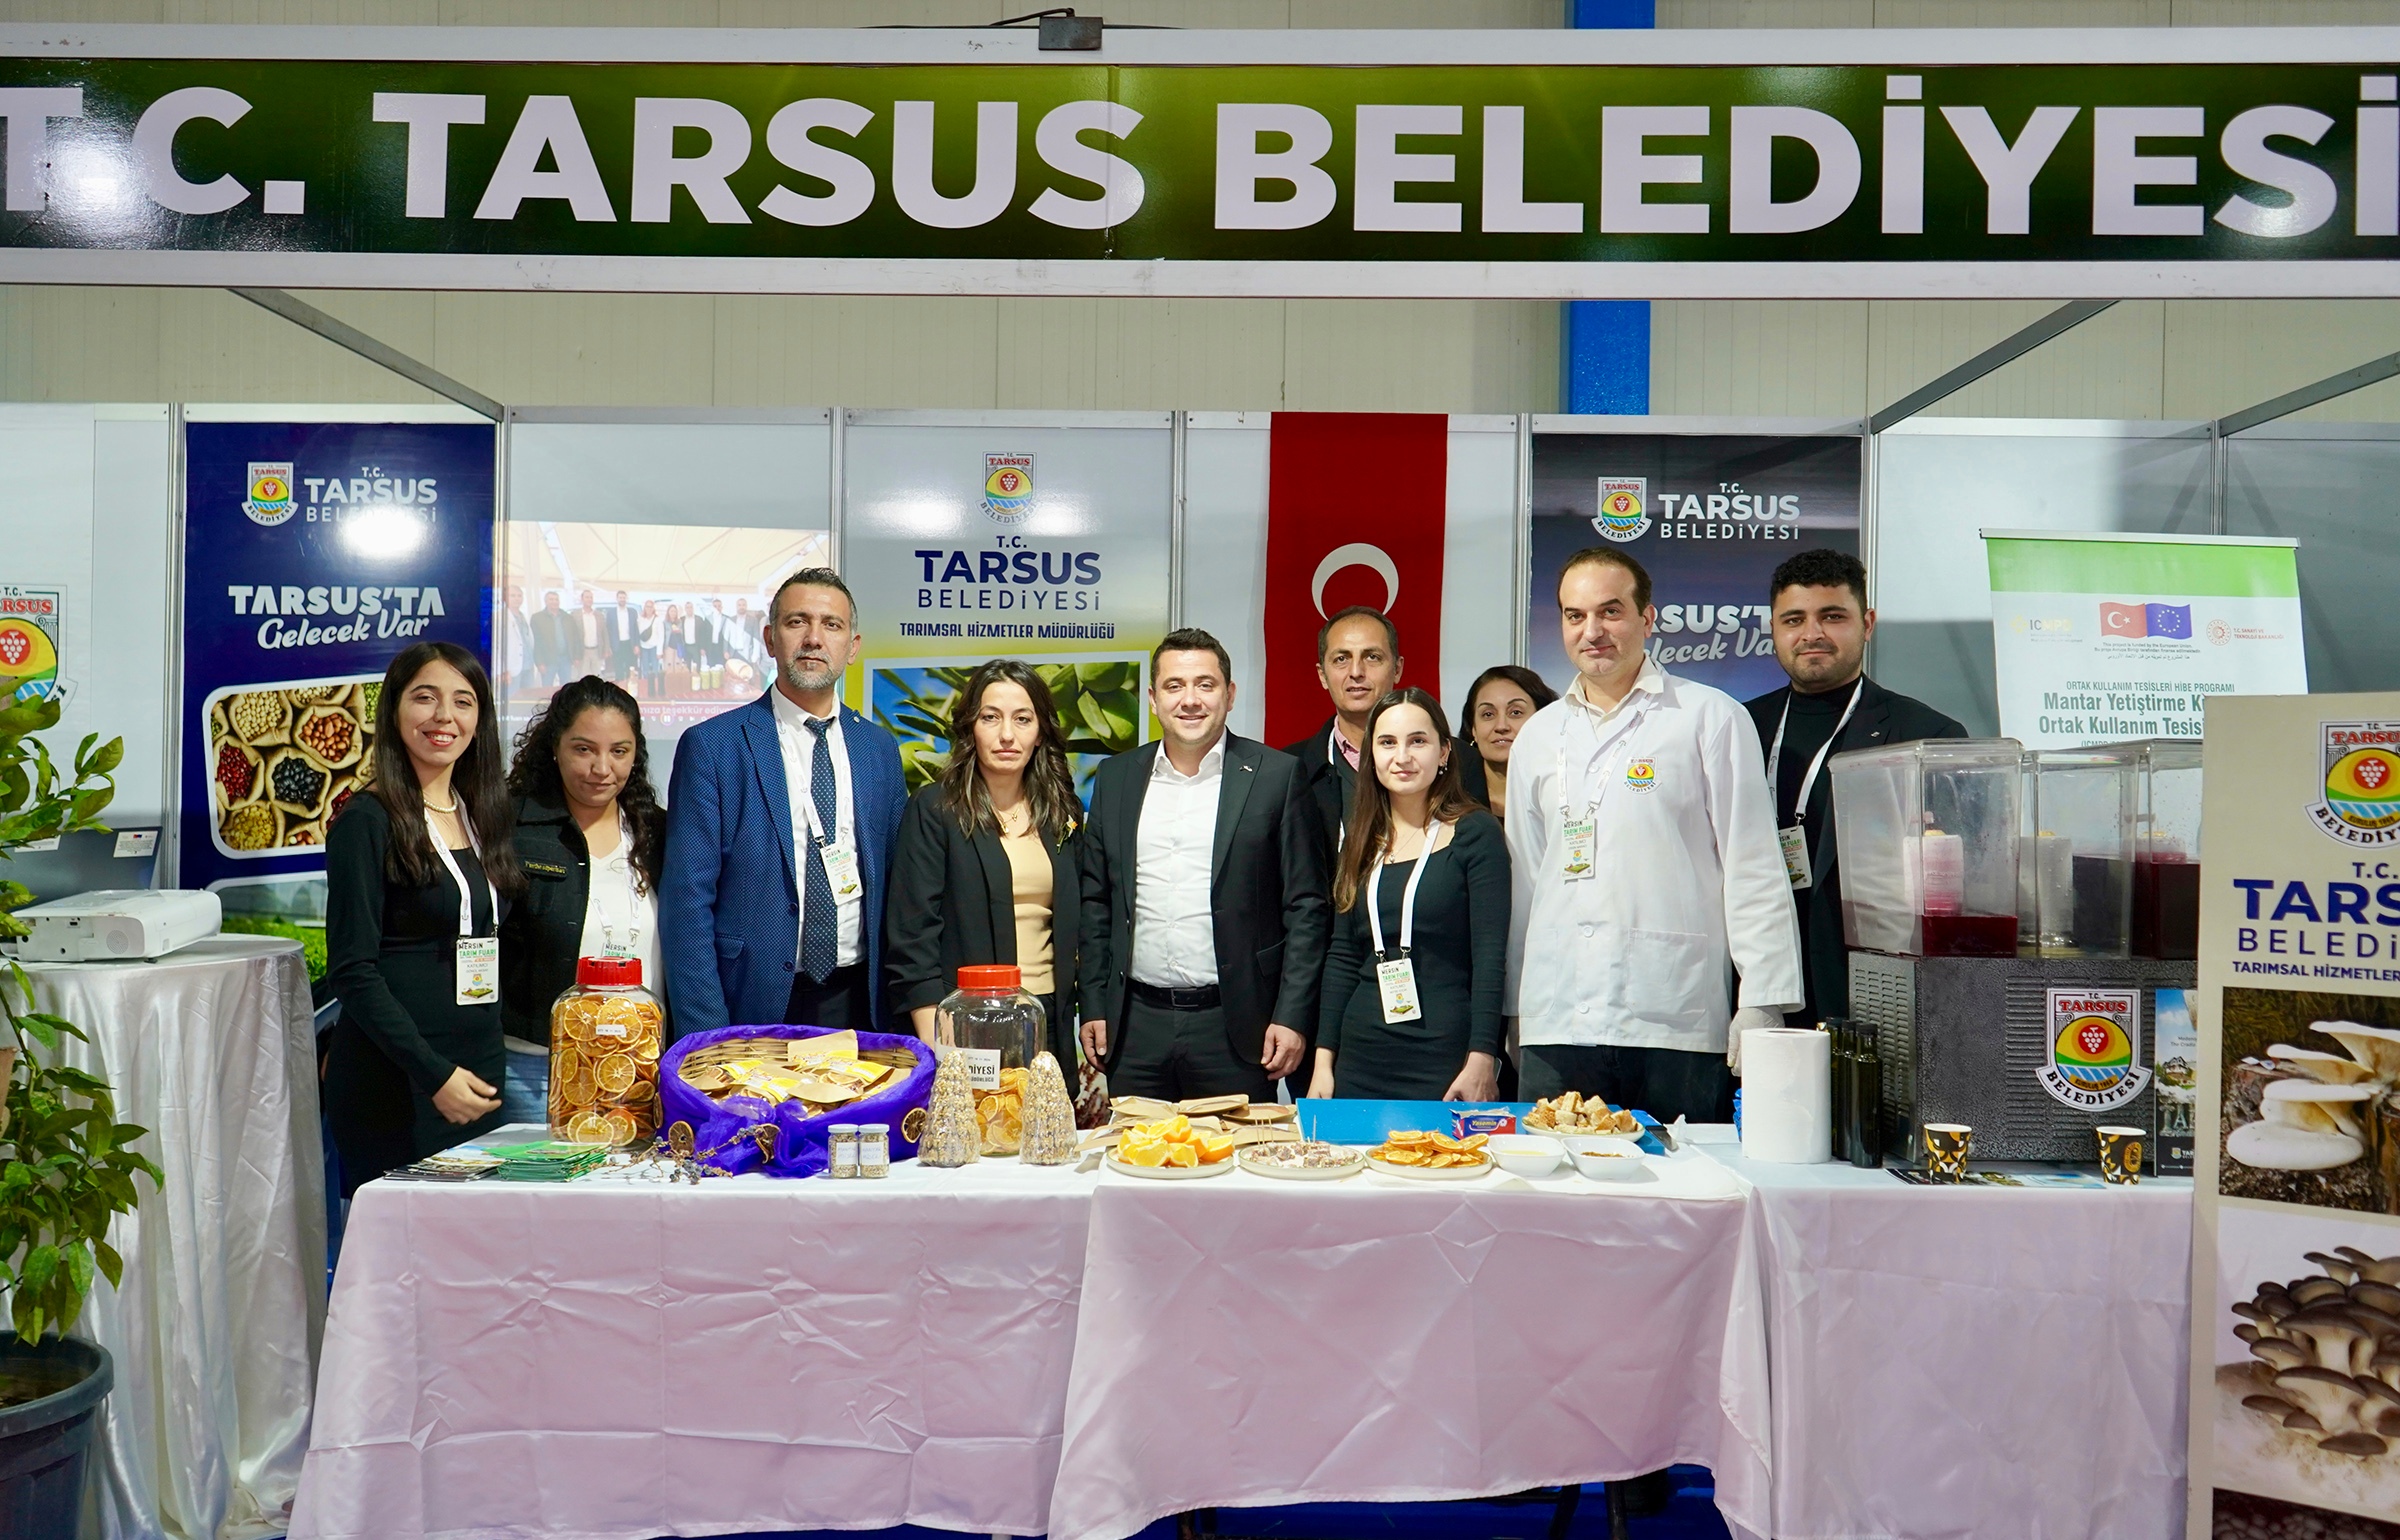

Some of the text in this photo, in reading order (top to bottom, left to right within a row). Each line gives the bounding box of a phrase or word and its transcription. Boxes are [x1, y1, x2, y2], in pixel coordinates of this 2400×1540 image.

[373, 93, 1146, 230] TARSUS
[1214, 75, 2400, 237] BELEDİYESİ
[988, 457, 1031, 466] TARSUS
[253, 468, 288, 476] TARSUS
[361, 466, 385, 478] T.C.
[304, 478, 438, 505] TARSUS
[1604, 483, 1640, 491] TARSUS
[1719, 483, 1744, 494] T.C.
[1658, 494, 1800, 521] TARSUS
[1597, 519, 1647, 540] BELEDİYESİ
[1660, 523, 1799, 540] BELEDİYESİ
[996, 535, 1027, 549] T.C.
[915, 550, 1101, 585] TARSUS
[4, 587, 22, 597] T.C.
[228, 585, 445, 616] TARSUS'TA
[918, 588, 1100, 611] BELEDİYESİ
[0, 598, 53, 615] RSUS
[257, 607, 430, 650] Gelecek Var
[900, 620, 1115, 640] TARIMSAL HİZMETLER MÜDÜRLÜĞÜ
[1735, 627, 1776, 658] Va
[2066, 681, 2235, 693] ORTAK KULLANIM TESİSLERİ HİBE PROGRAMI
[662, 705, 702, 716] teşekkür
[2044, 692, 2101, 711] Mantar
[2107, 693, 2186, 716] Yetiştirme
[2039, 715, 2084, 734] Ortak
[2089, 716, 2158, 735] Kullanım
[2315, 807, 2400, 844] BELEDİY
[2352, 862, 2399, 880] T.C.
[2238, 927, 2397, 960] BELEDİ
[2232, 961, 2400, 982] TARIMSAL HİZMETLER
[2088, 992, 2101, 1000] T.C.
[2058, 1000, 2128, 1013] TARSUS
[2045, 1071, 2140, 1105] BELEDİYESİ
